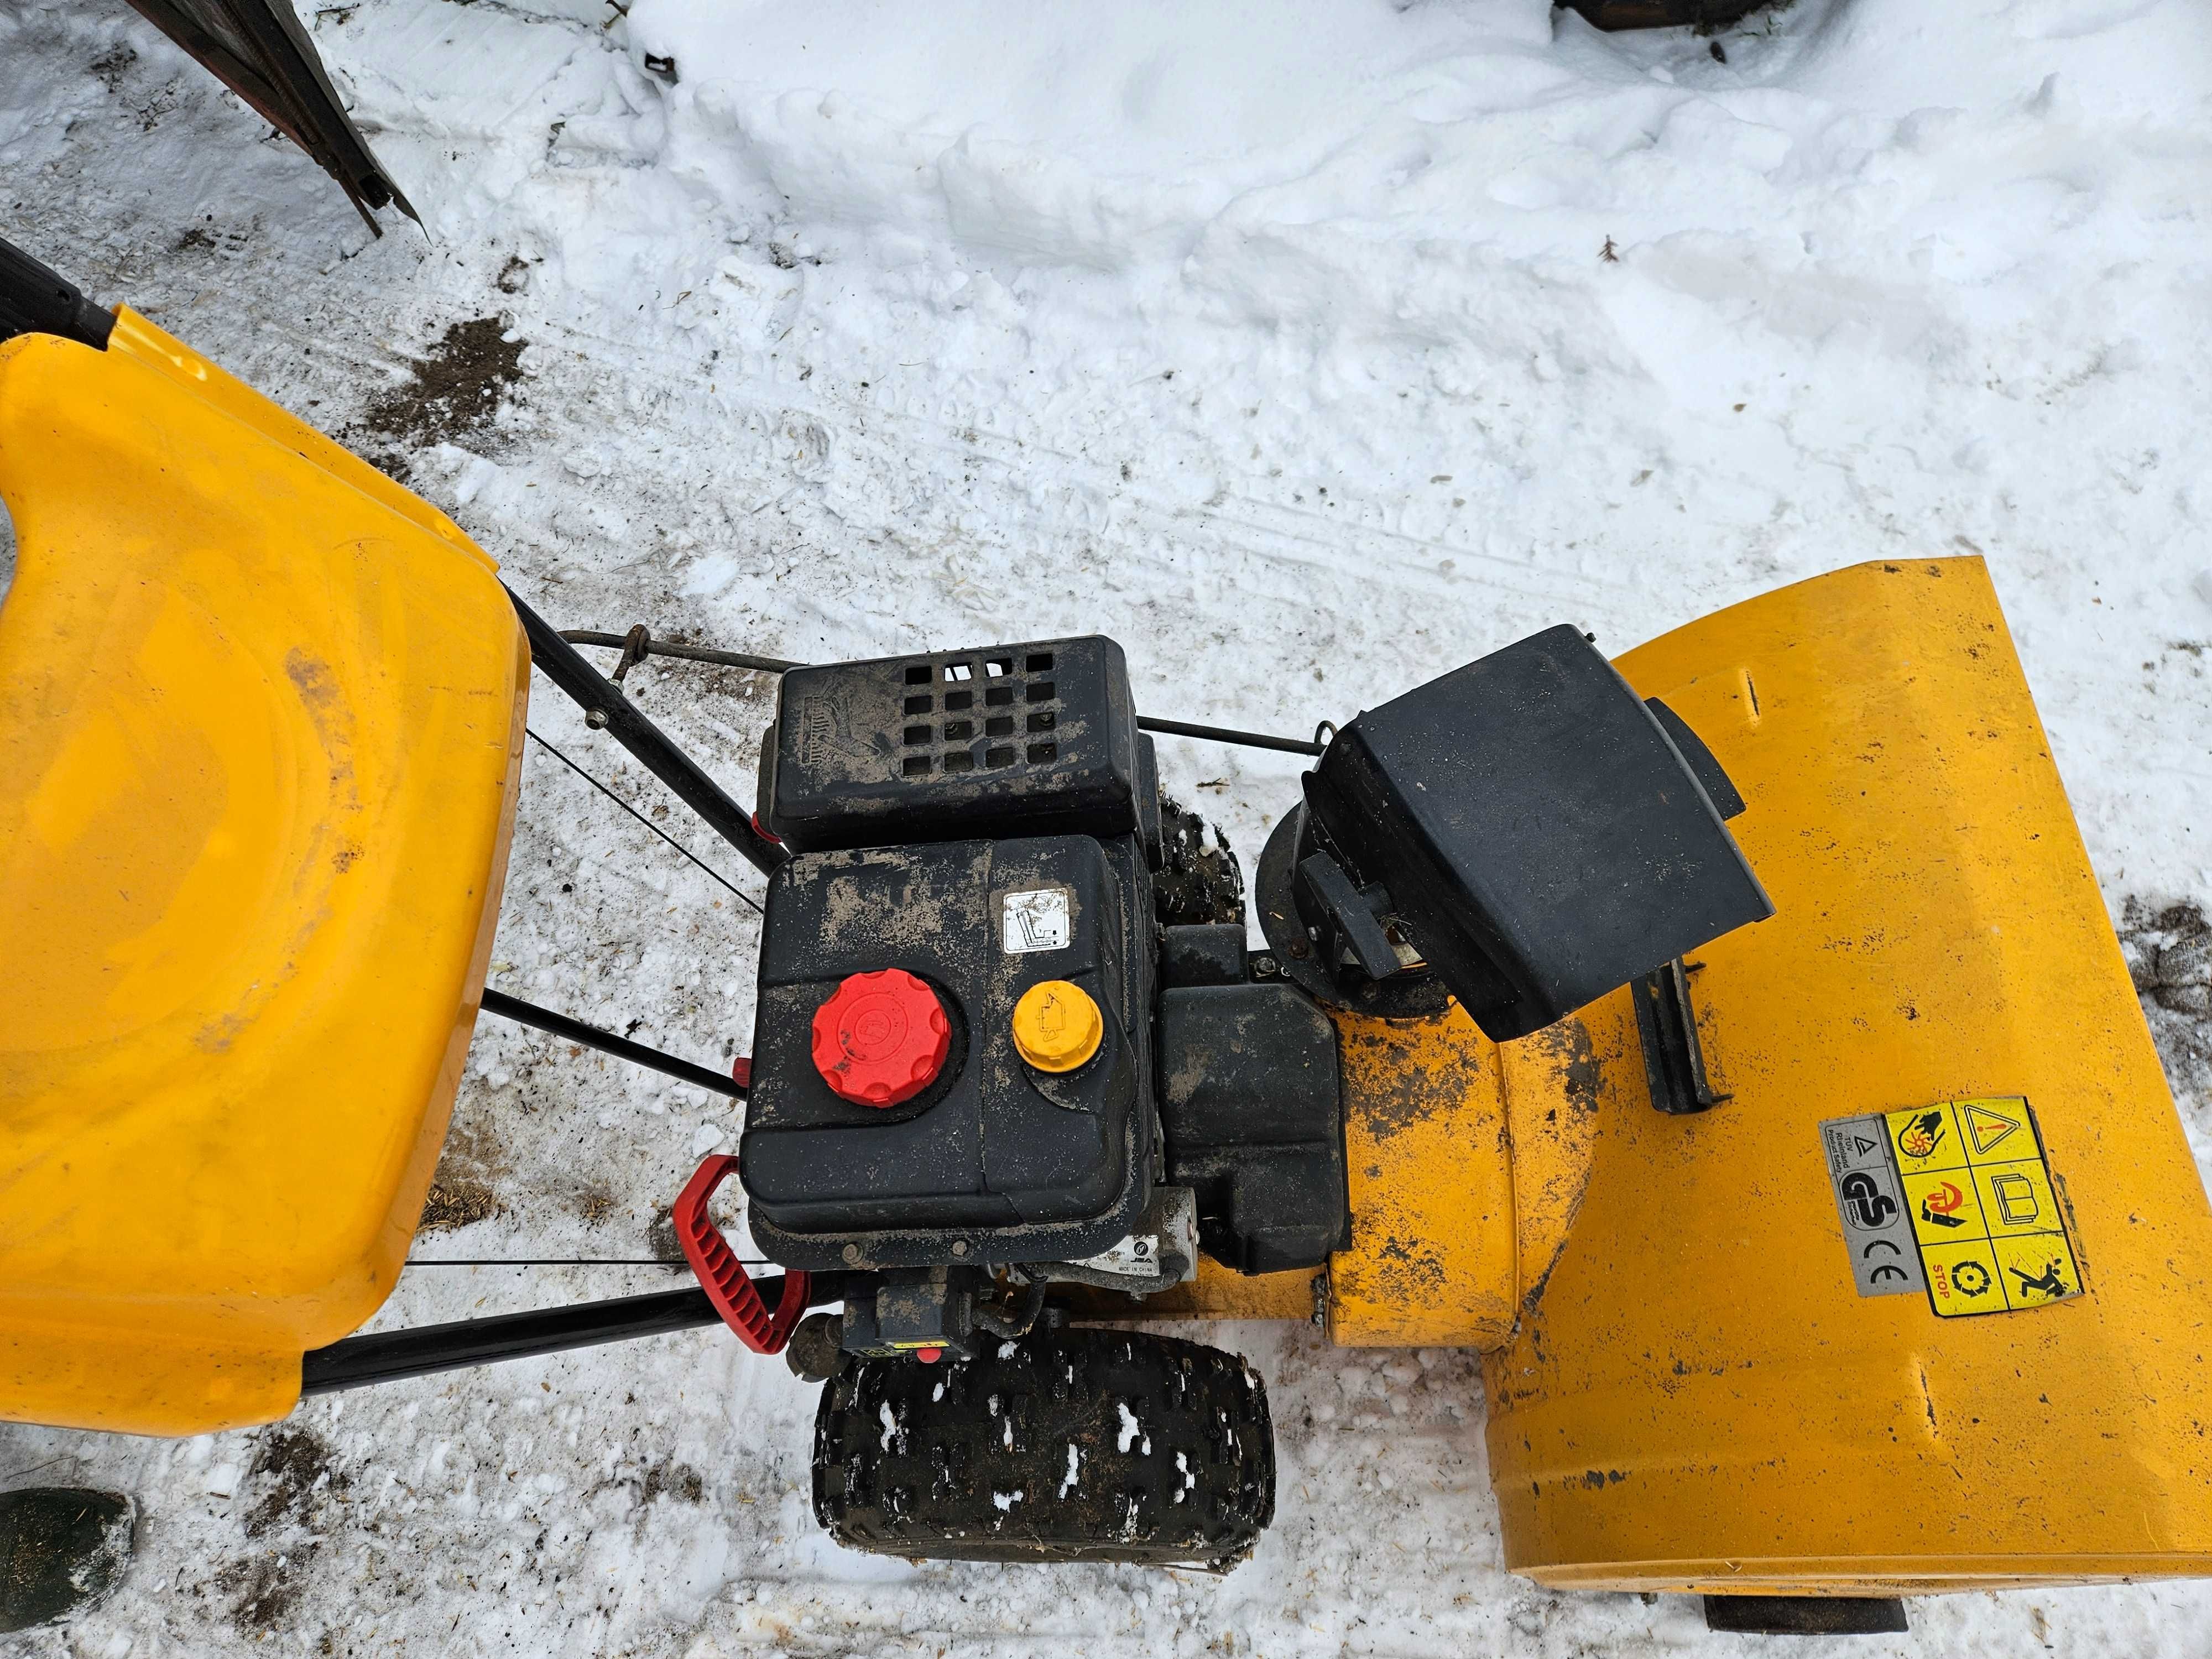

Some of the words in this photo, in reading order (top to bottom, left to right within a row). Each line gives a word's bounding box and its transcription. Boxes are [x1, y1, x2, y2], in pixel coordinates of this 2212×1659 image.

[1828, 1129, 1838, 1154] Product
[1834, 1154, 1842, 1173] Safety
[1835, 1132, 1850, 1168] Rheinland
[1844, 1136, 1854, 1151] TÜV
[1841, 1172, 1897, 1227] GS
[1864, 1240, 1909, 1284] CE
[1933, 1264, 1950, 1299] STOP
